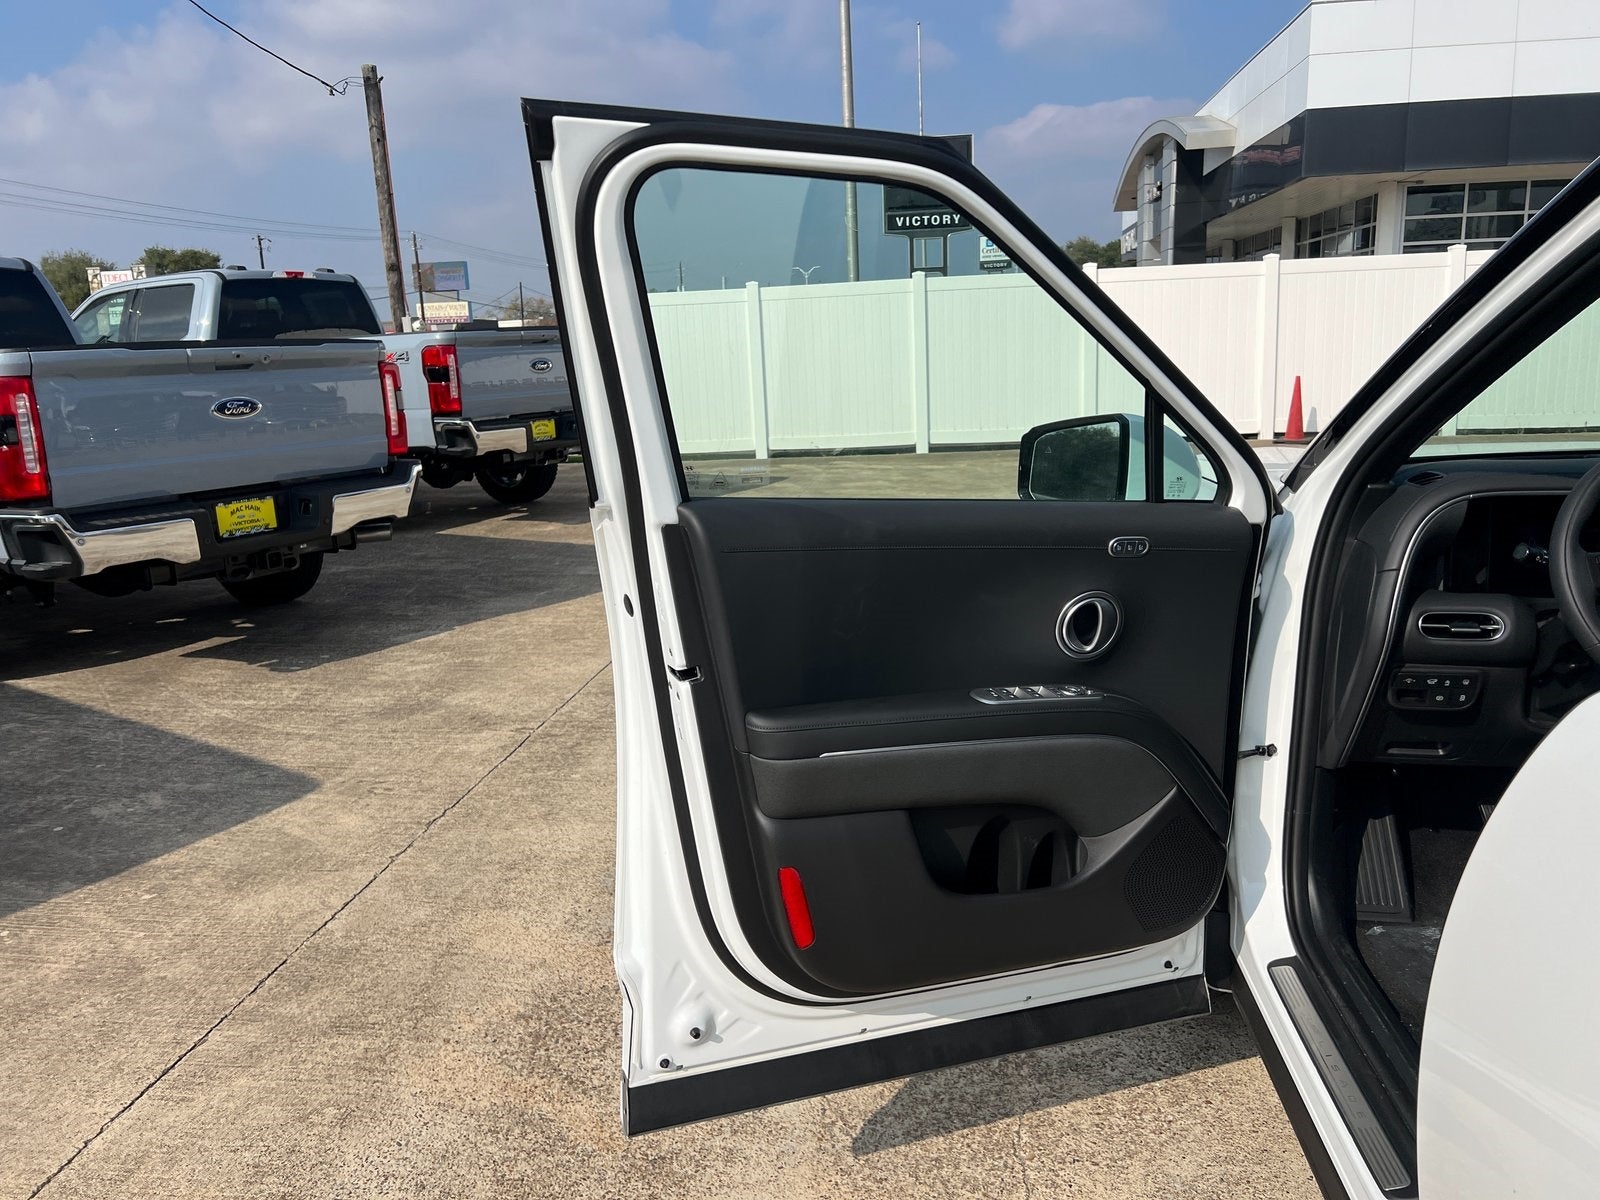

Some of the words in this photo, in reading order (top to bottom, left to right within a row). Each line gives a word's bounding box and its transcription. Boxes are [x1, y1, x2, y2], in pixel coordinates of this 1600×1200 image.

[895, 214, 960, 227] VICTORY
[224, 401, 252, 415] Ford
[230, 505, 244, 517] MAC
